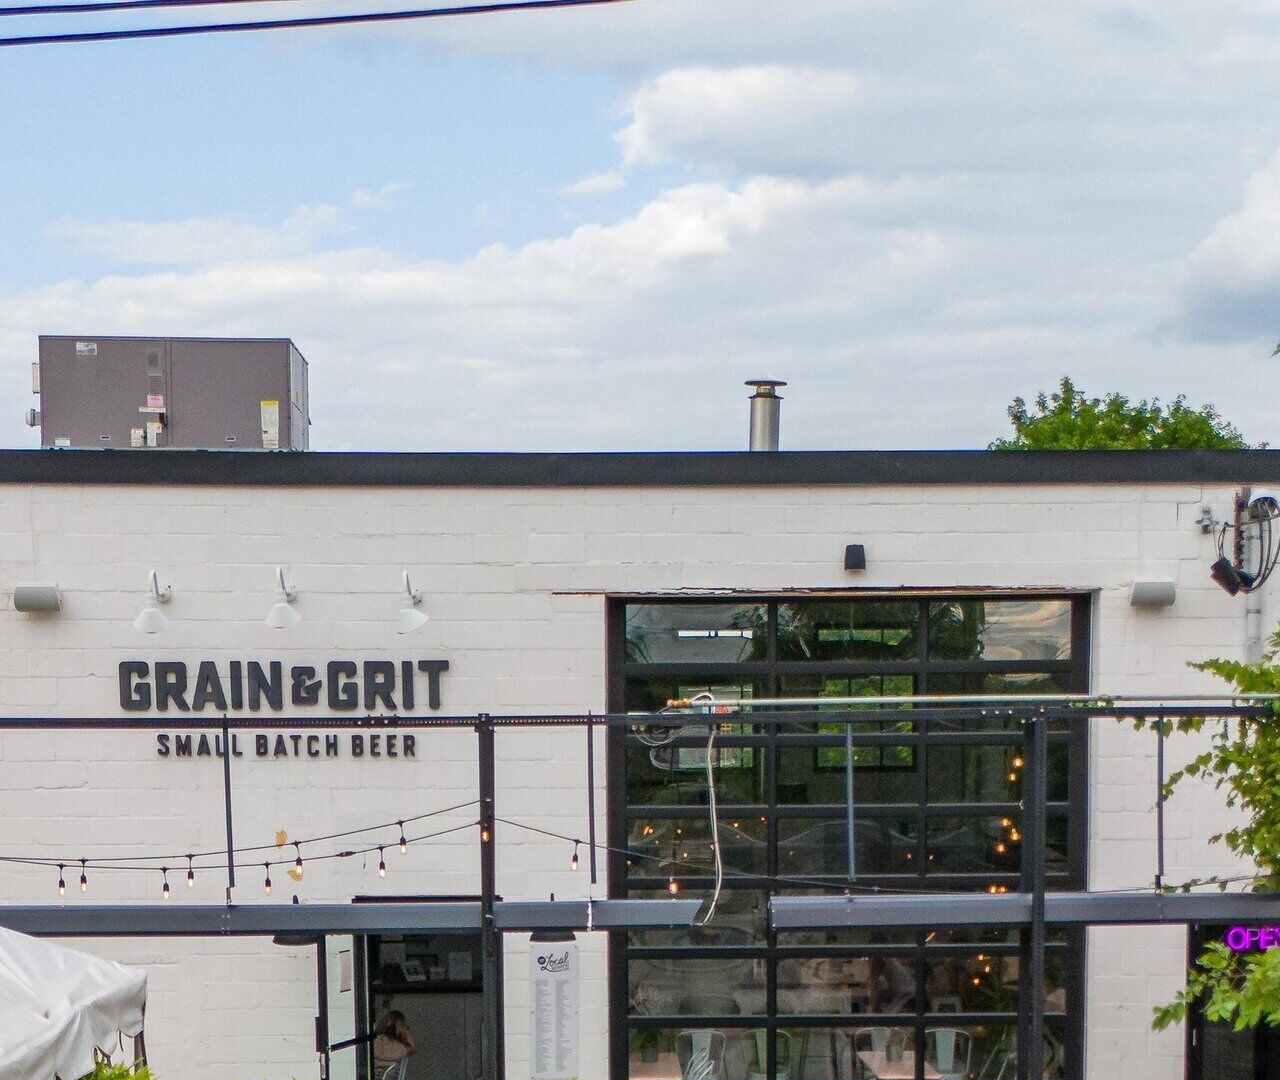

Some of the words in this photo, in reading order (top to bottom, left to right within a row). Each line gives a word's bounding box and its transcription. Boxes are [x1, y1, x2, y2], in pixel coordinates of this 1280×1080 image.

[157, 734, 243, 758] SMALL
[256, 734, 338, 758] BATCH
[352, 734, 417, 758] BEER
